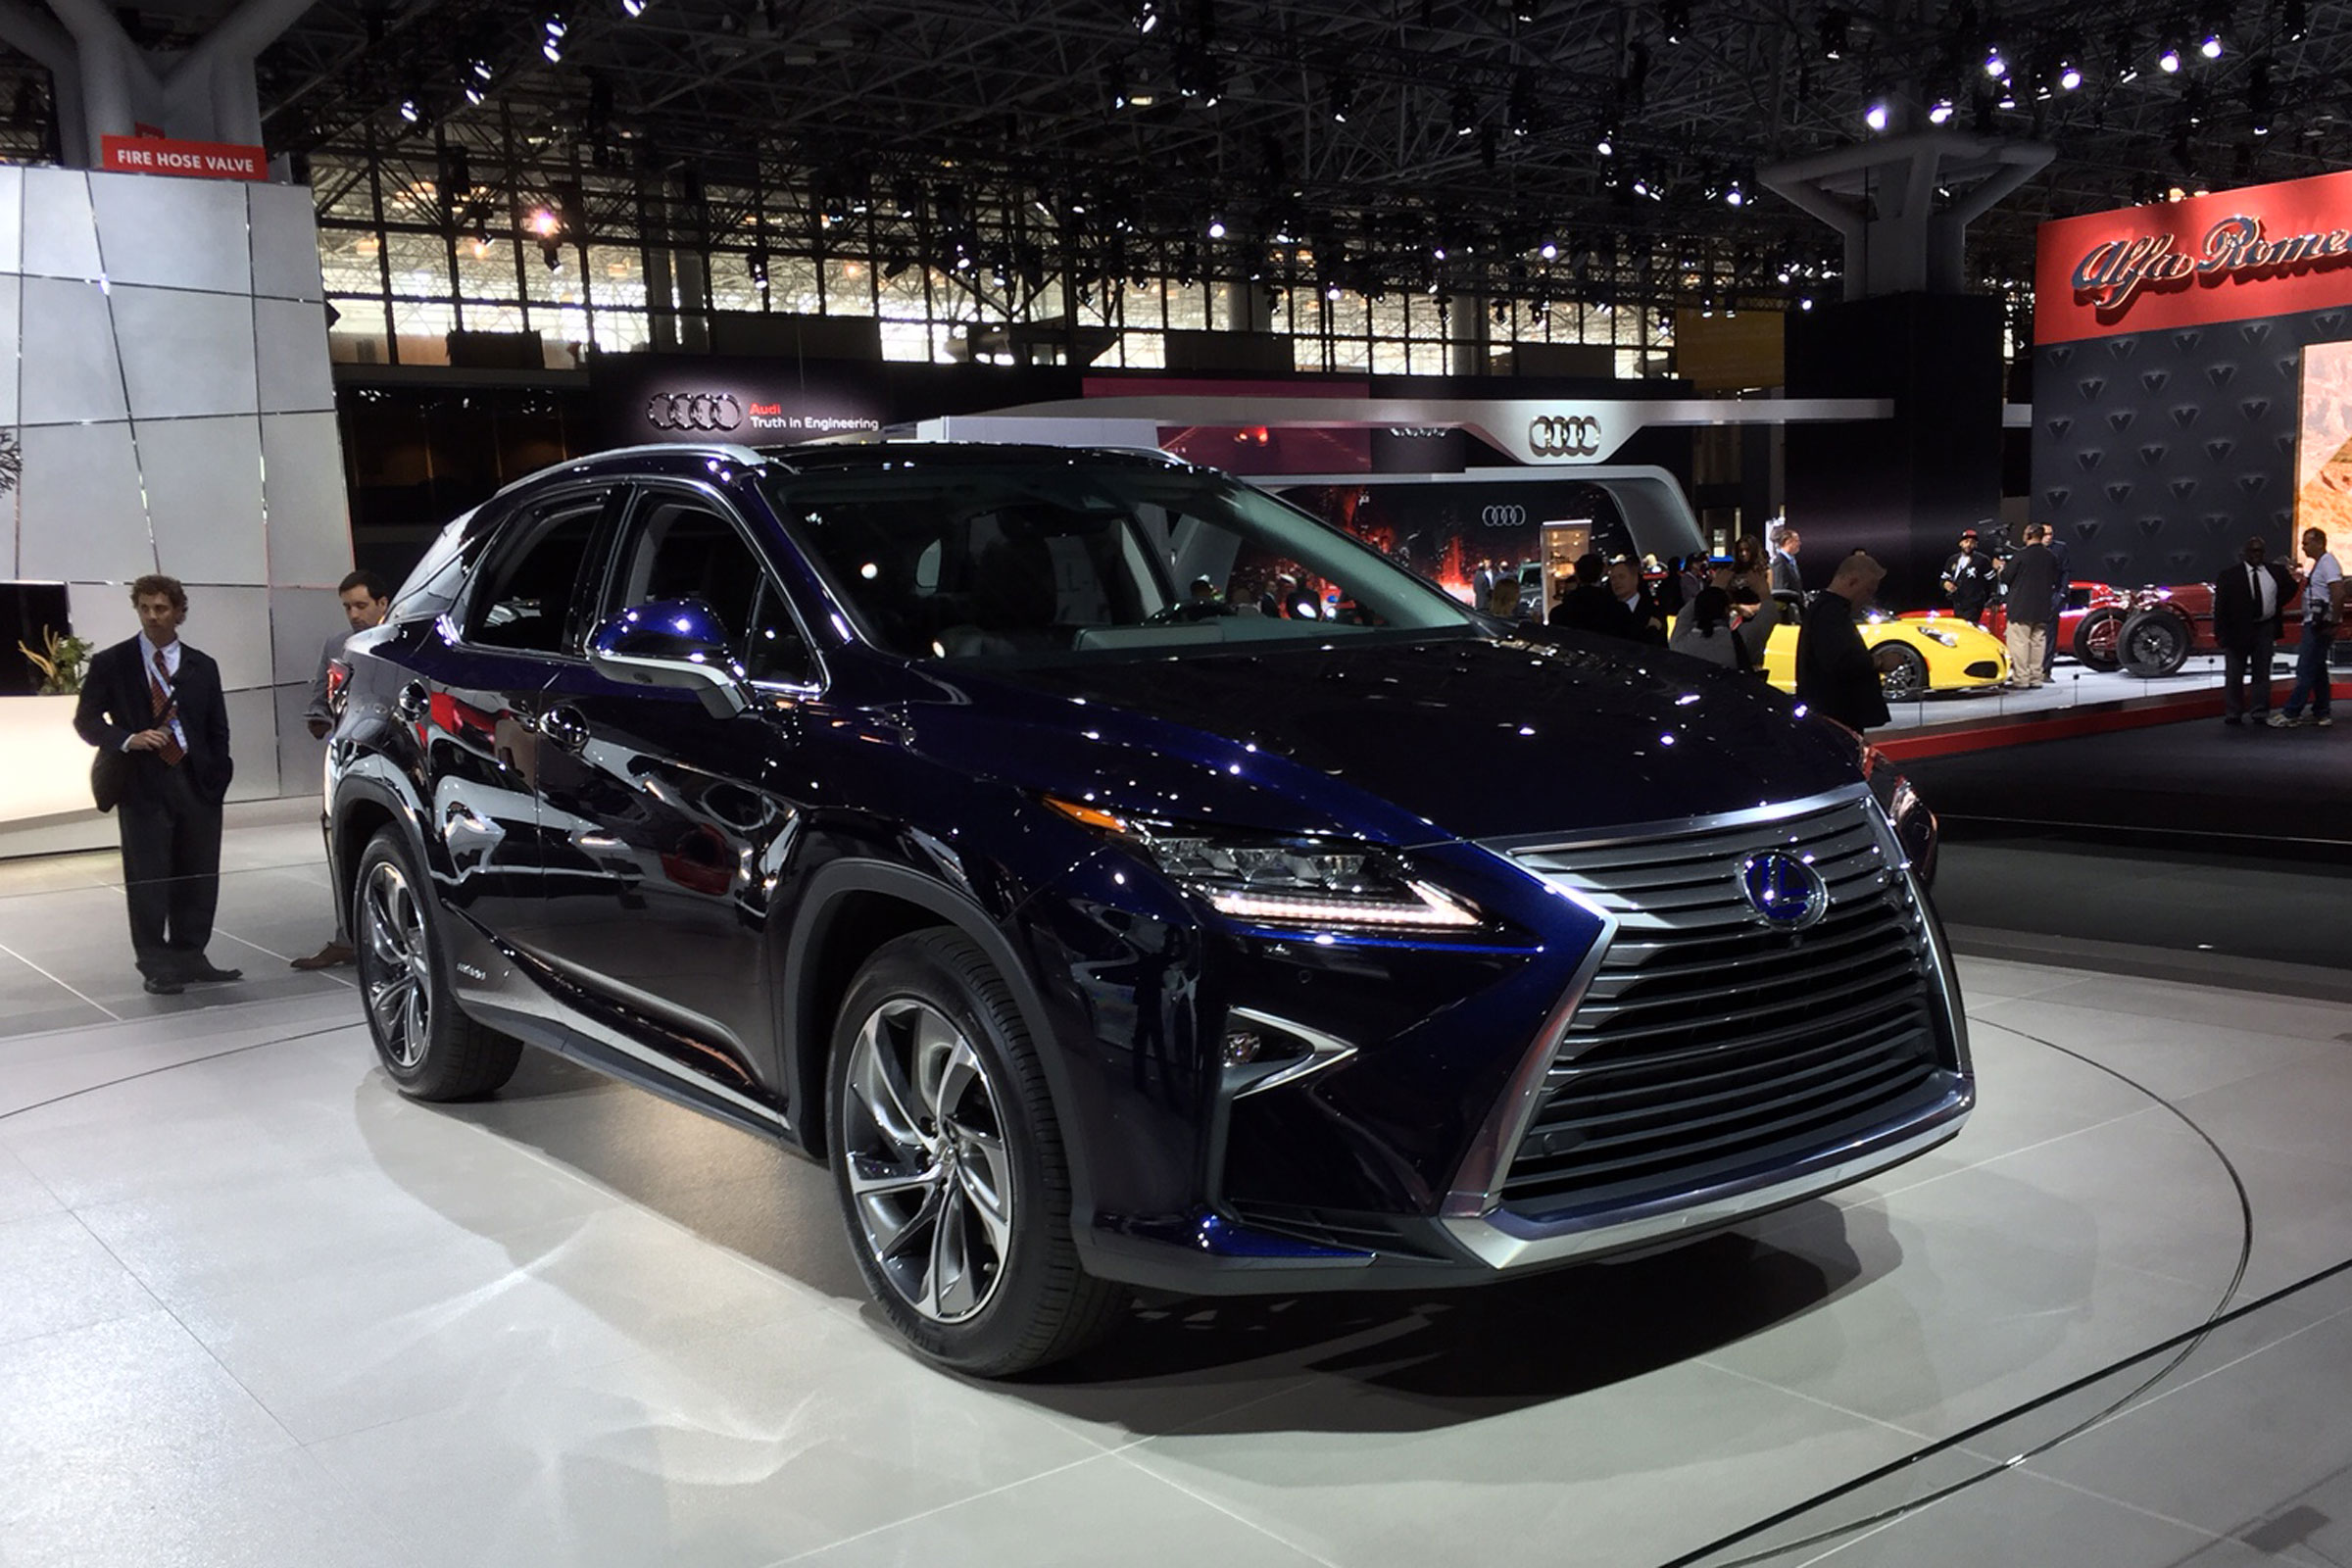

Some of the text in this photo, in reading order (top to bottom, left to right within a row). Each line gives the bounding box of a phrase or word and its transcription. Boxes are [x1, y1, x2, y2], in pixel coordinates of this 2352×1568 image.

[117, 149, 254, 172] FIRE HOSE VALVE
[2071, 214, 2352, 310] Alfa Rome
[749, 403, 781, 416] Audi
[751, 416, 879, 432] Truth in Engineering
